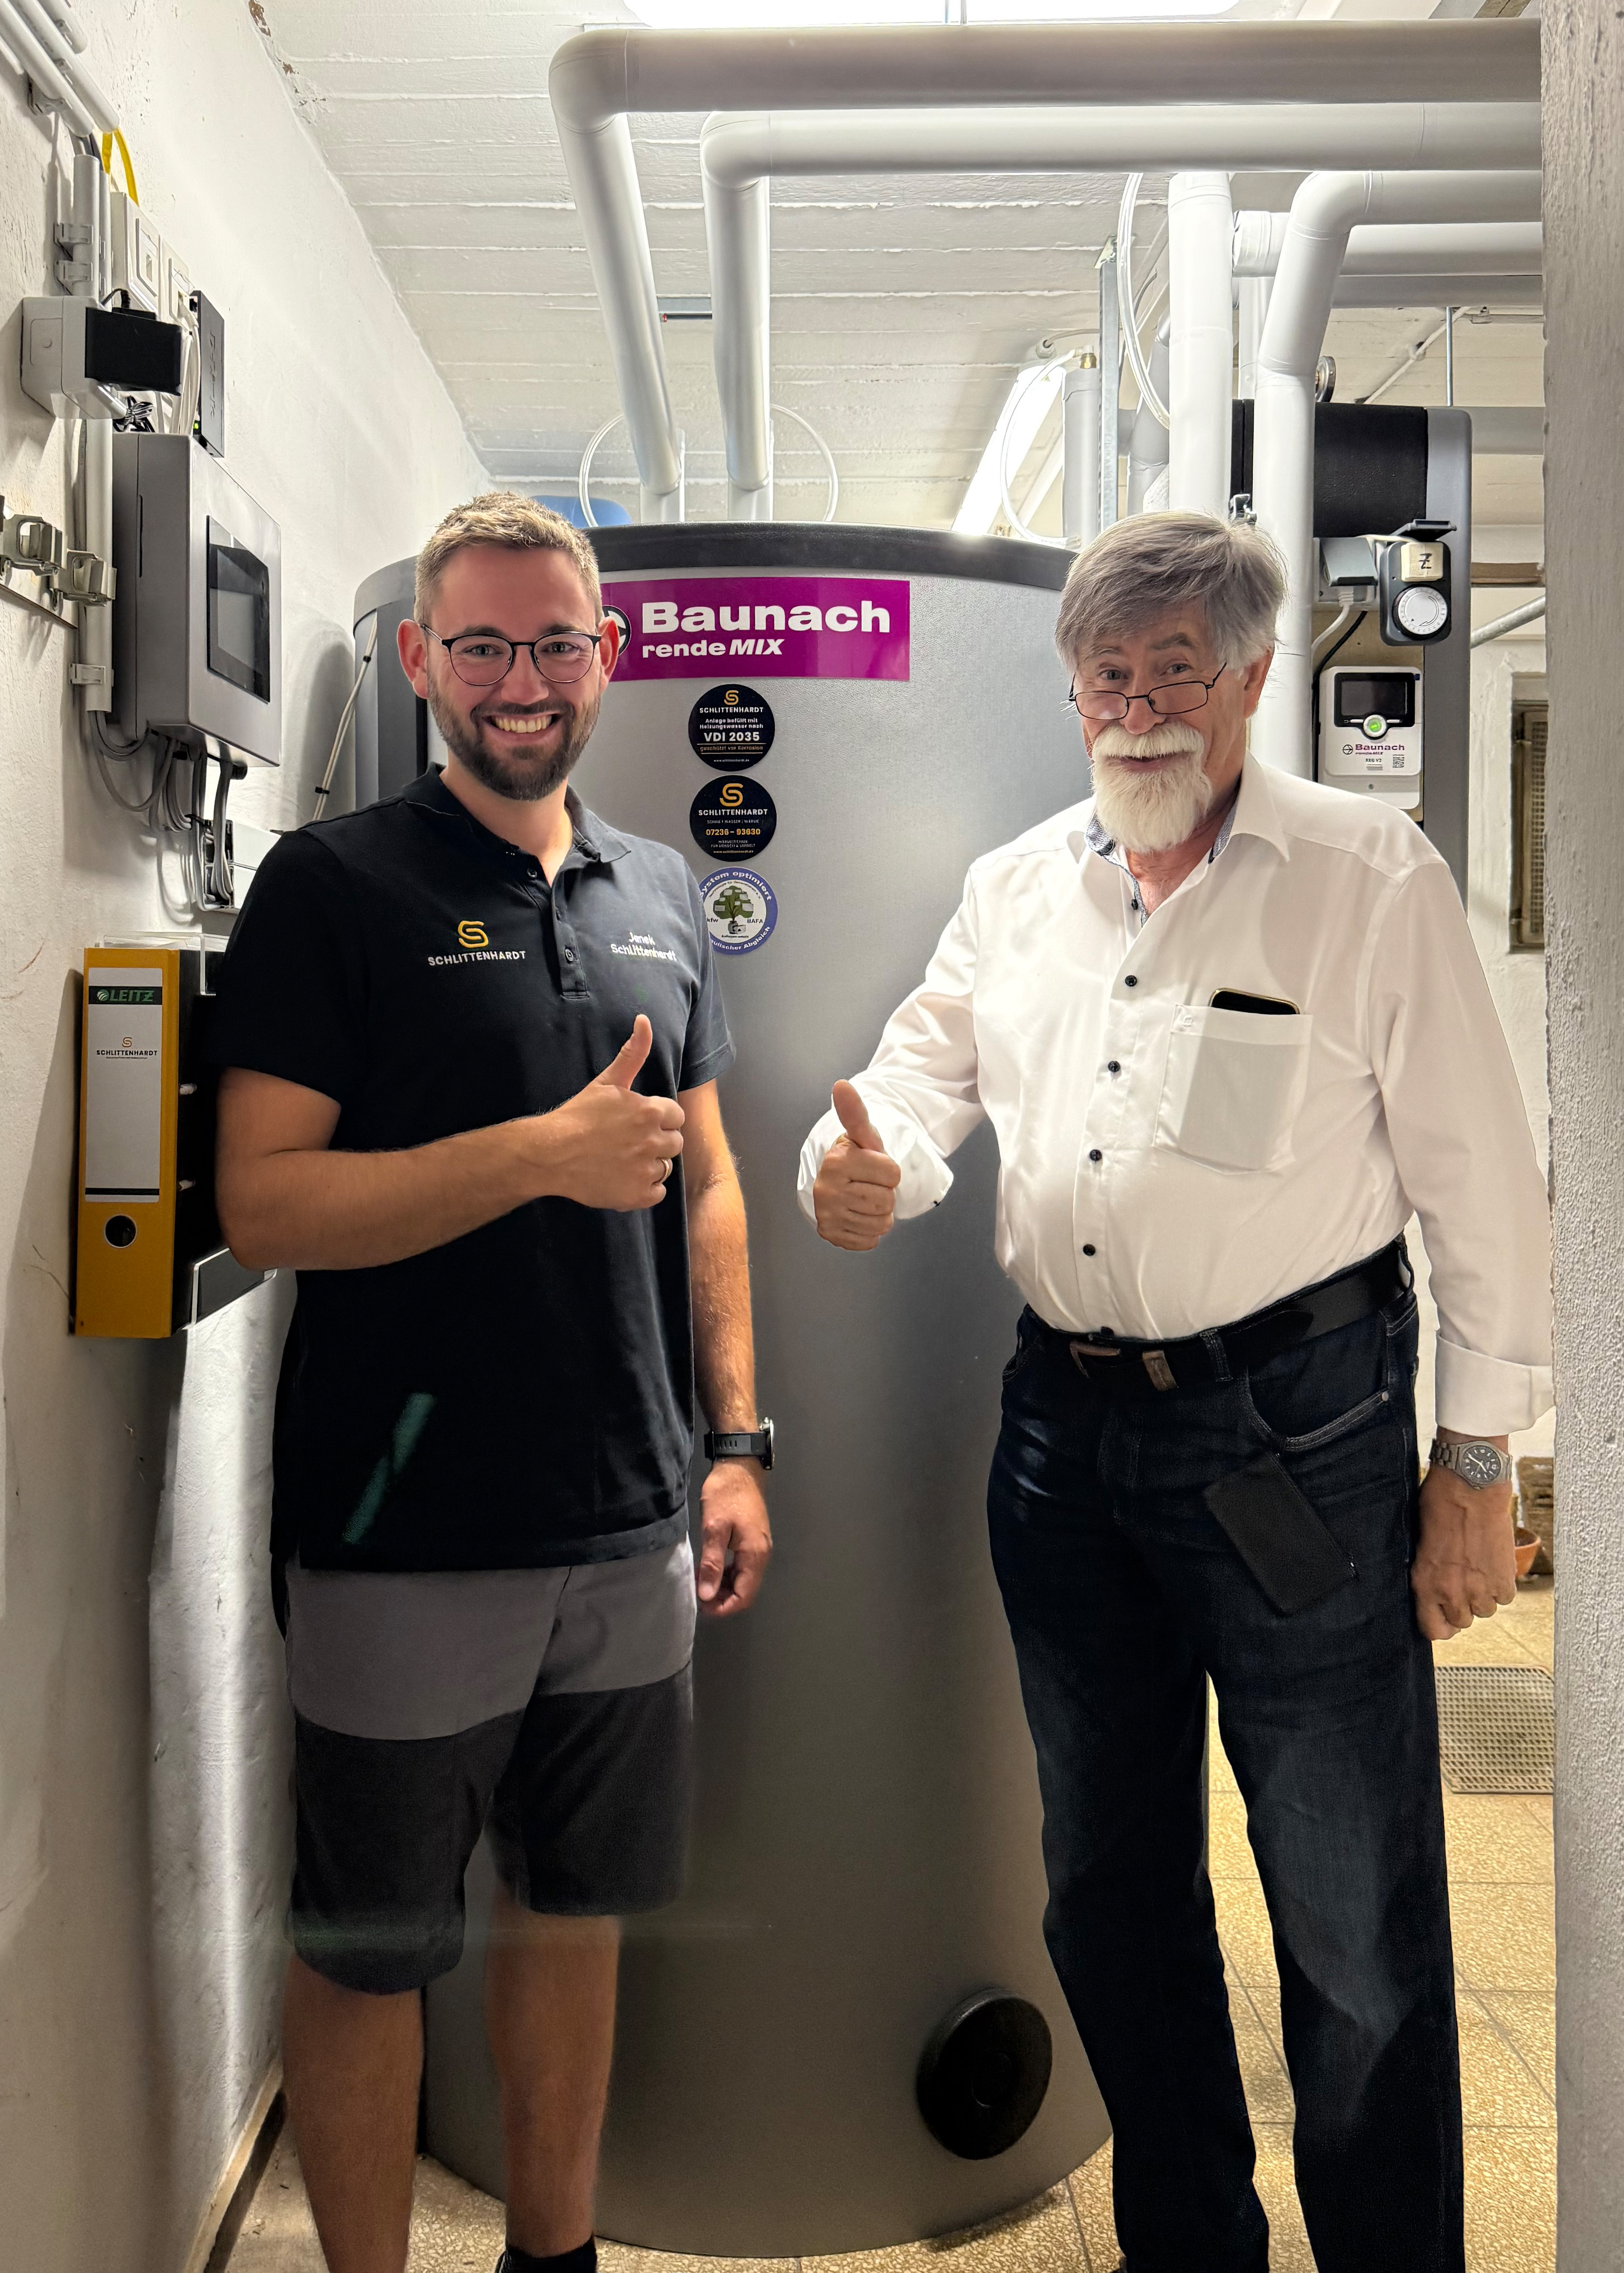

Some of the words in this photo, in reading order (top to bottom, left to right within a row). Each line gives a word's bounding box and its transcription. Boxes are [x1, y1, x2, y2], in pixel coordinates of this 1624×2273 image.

[642, 600, 890, 633] Baunach
[704, 732, 725, 741] VDI
[729, 732, 760, 741] 2035
[629, 932, 655, 945] Janek
[428, 951, 526, 966] SCHLITTENHARDT
[610, 943, 677, 961] Schlittenhardt
[110, 989, 154, 1002] LEITZ
